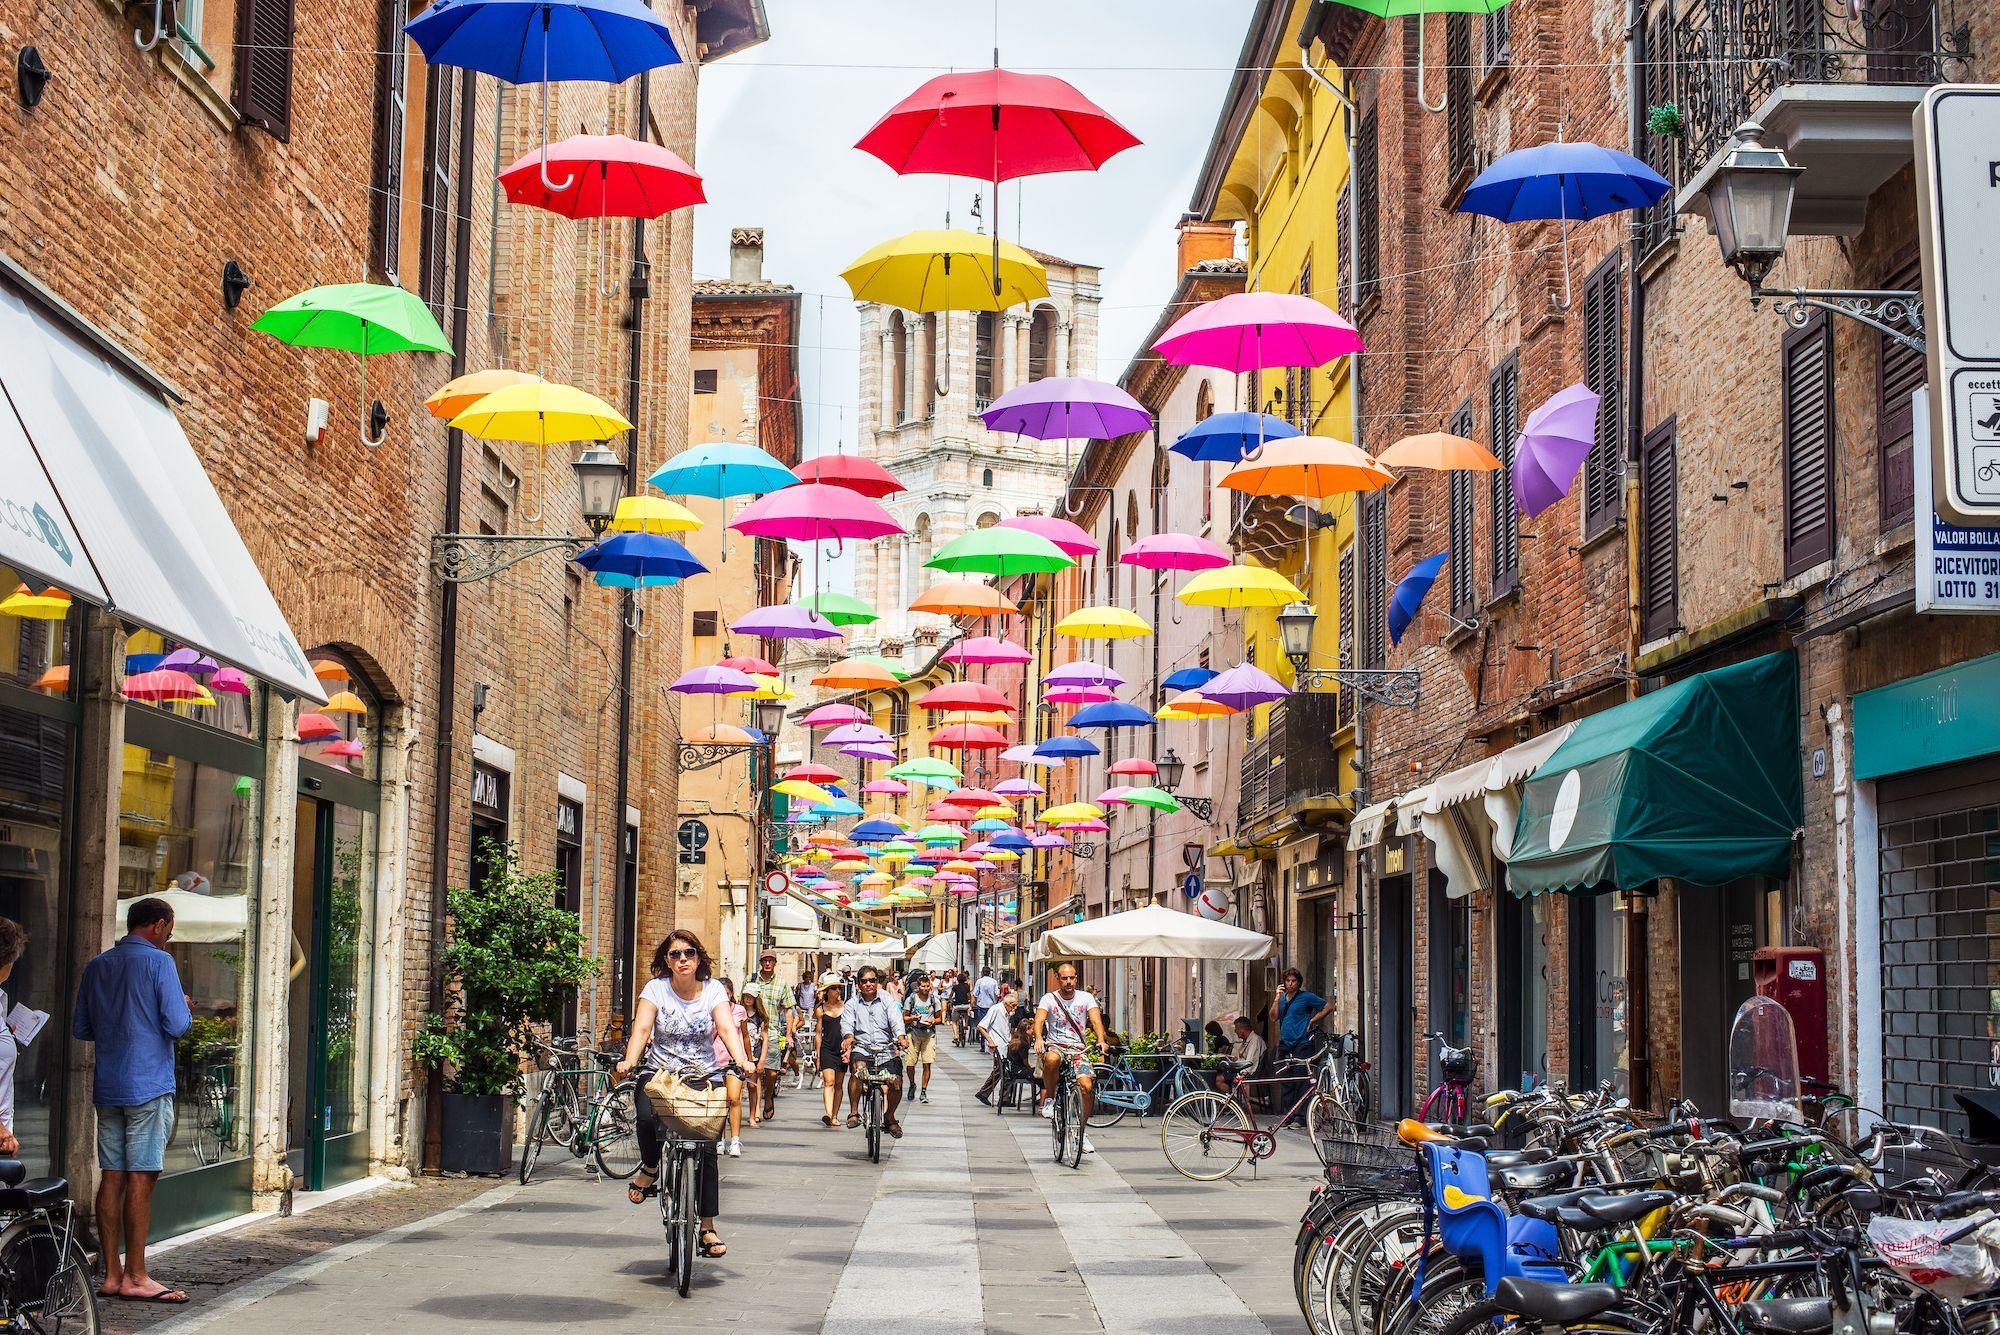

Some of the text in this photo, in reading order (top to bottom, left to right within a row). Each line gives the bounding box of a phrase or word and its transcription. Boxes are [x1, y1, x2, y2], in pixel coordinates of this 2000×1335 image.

[1934, 530, 2000, 545] VALORI BOLLA
[1938, 580, 2000, 599] LOTTO 31
[1814, 753, 1825, 775] 69
[474, 769, 498, 809] ZARA
